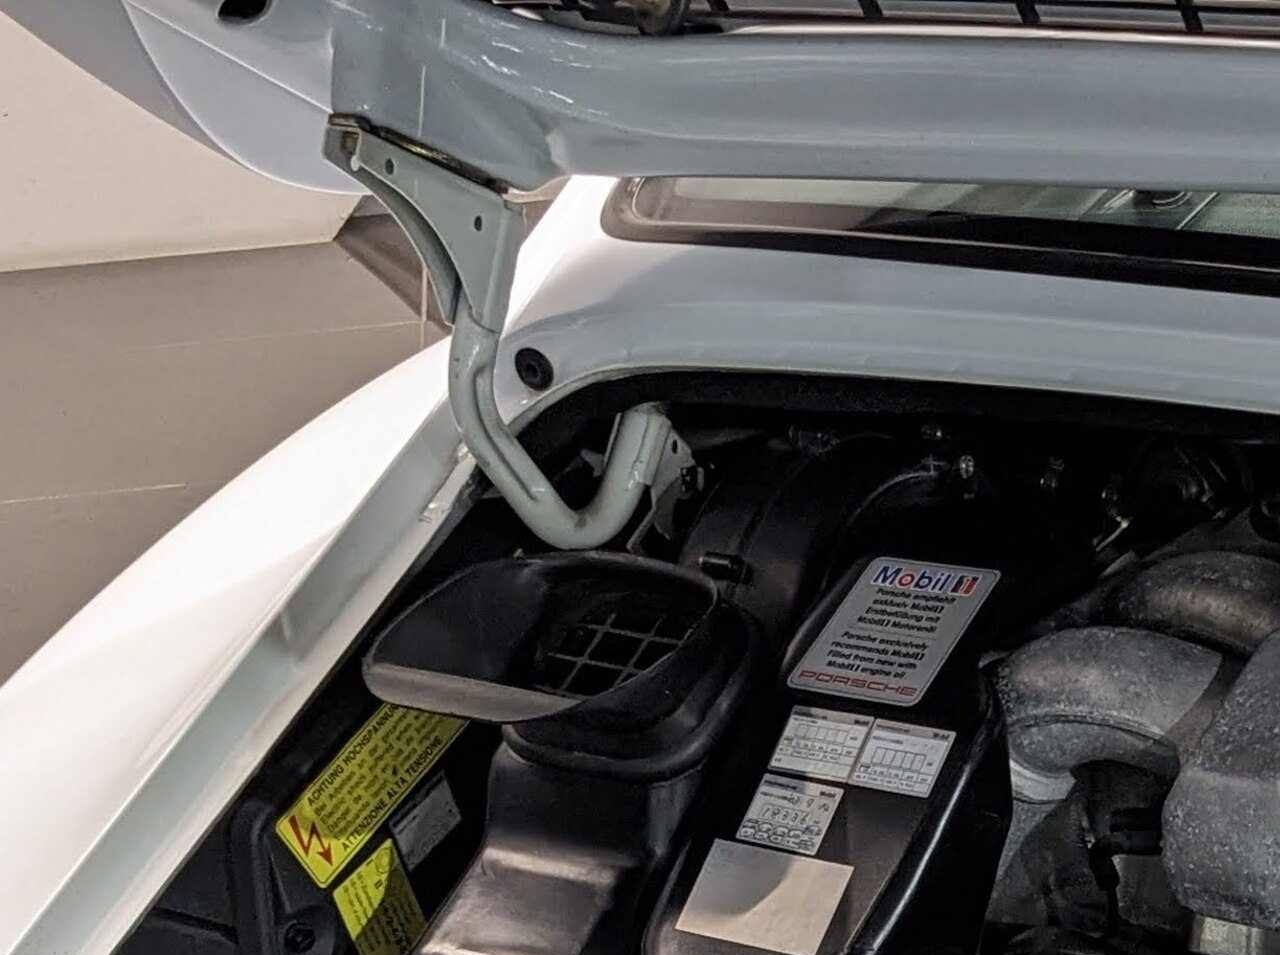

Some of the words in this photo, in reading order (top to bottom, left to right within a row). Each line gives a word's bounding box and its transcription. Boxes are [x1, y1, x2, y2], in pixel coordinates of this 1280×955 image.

[872, 565, 952, 590] Mobil
[798, 670, 917, 696] PORSCHE
[306, 762, 344, 807] ACHTUNG
[342, 797, 387, 852] ATTENZIONE
[386, 773, 408, 801] ALTA
[406, 733, 442, 778] TENSIONE
